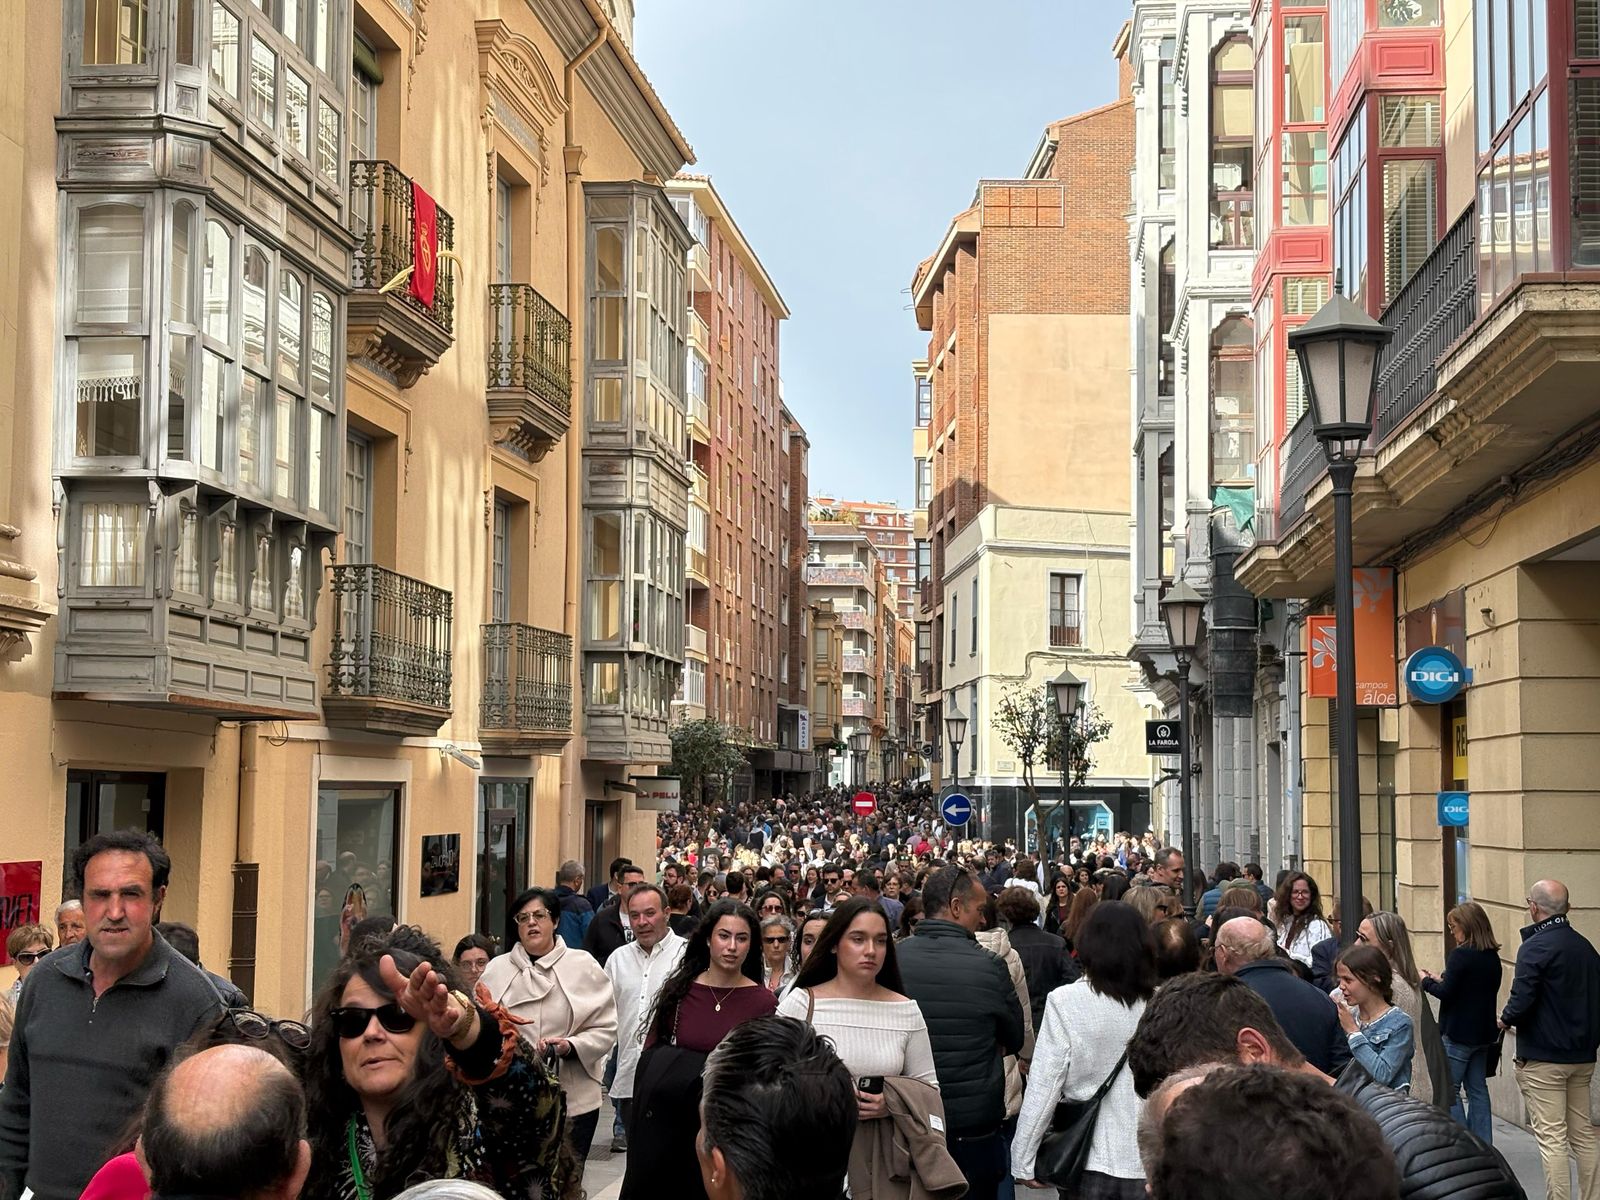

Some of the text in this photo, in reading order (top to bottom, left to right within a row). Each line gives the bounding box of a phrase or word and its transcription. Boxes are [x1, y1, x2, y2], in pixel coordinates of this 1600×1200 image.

[1411, 671, 1459, 682] DIGI
[1362, 690, 1396, 705] aloe
[1456, 724, 1468, 757] RE
[652, 791, 679, 799] PELU
